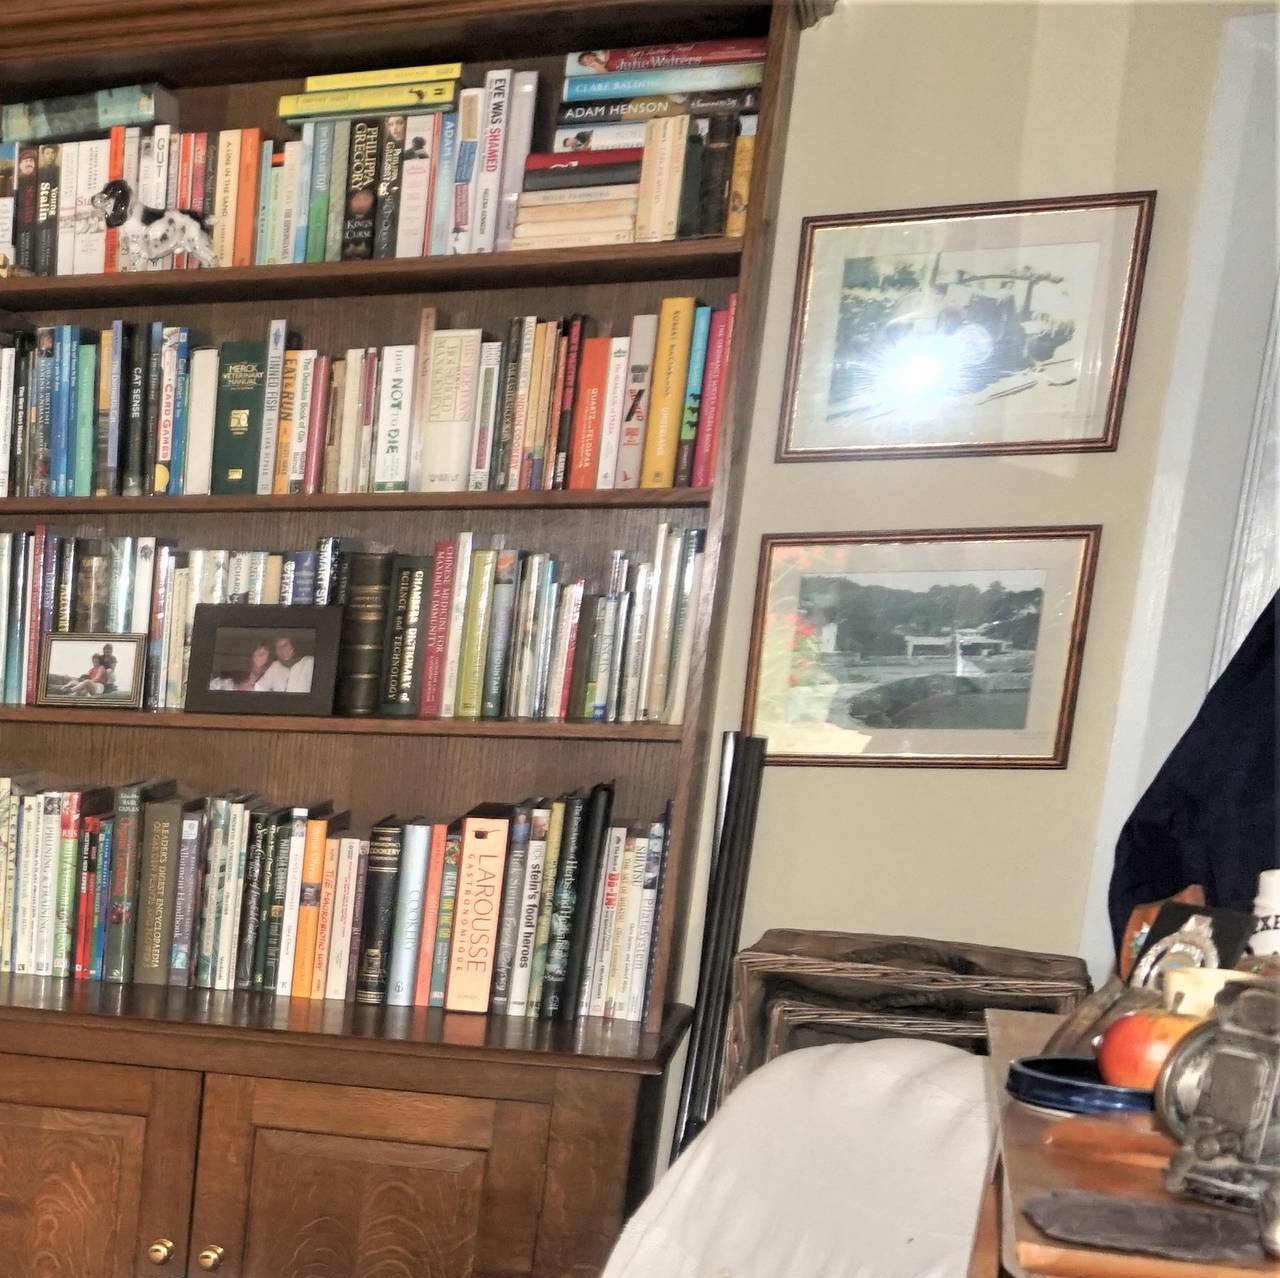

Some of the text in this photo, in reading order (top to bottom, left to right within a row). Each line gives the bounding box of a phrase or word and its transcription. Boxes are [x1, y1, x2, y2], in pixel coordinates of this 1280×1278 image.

[615, 54, 702, 72] Julie Walters
[486, 78, 507, 172] EVE WAS SHAMED
[564, 101, 669, 119] ADAM HENSON
[351, 123, 379, 191] PHILIPPA GREGORY
[443, 121, 454, 156] ADAM
[40, 182, 58, 223] Young Stalin
[718, 324, 726, 337] THE
[303, 358, 312, 371] The
[394, 349, 404, 375] HOW
[711, 339, 724, 379] ORDNANCE
[131, 367, 142, 418] CAT SENSE
[266, 355, 281, 412] TINNED FISH
[390, 378, 404, 410] NOT
[709, 380, 719, 405] SURVEY
[161, 383, 174, 460] CARD GAMES
[299, 402, 308, 420] Book
[510, 394, 527, 469] INDIAN COOKERY
[583, 388, 599, 467] QUARTZ FELDSPAR
[297, 431, 306, 444] Gin
[385, 429, 400, 455] DIE
[703, 433, 713, 453] BOOK
[556, 452, 567, 483] HAMLYN
[233, 558, 243, 593] RICHARD
[317, 543, 329, 585] SMART
[428, 551, 445, 649] MAXIMUM IMMUNITY
[435, 546, 455, 653] CHINESE MEDICINE FOR
[388, 570, 410, 700] SCIENCE and TECHNOLOGY
[400, 570, 425, 702] CHAMBERS DICTIONARY of
[491, 651, 502, 694] MOUNTAIN
[8, 802, 18, 881] CLEMATIS
[43, 826, 56, 873] PRUNING
[528, 863, 542, 900] stein's
[562, 859, 578, 890] Herbs
[633, 845, 647, 888] SHIATSU
[40, 884, 53, 932] TRAINING
[151, 821, 171, 968] READER'S DIGEST ENCYCLOPAEDIA
[173, 844, 190, 939] Allotment Handbook
[438, 871, 458, 940] VEGAN ON THE GO
[455, 853, 475, 972] GASTRONOMIQUE
[467, 854, 499, 973] LAROUSSE
[559, 889, 574, 909] and
[316, 869, 335, 972] THE MACROBIOTIC WAY
[405, 889, 421, 952] COOKERY
[496, 849, 525, 991] Rick Stein's French Odyssey
[523, 903, 538, 929] food
[554, 909, 572, 961] Herbalism
[634, 897, 656, 971] PilateSystem
[519, 930, 535, 969] heroes
